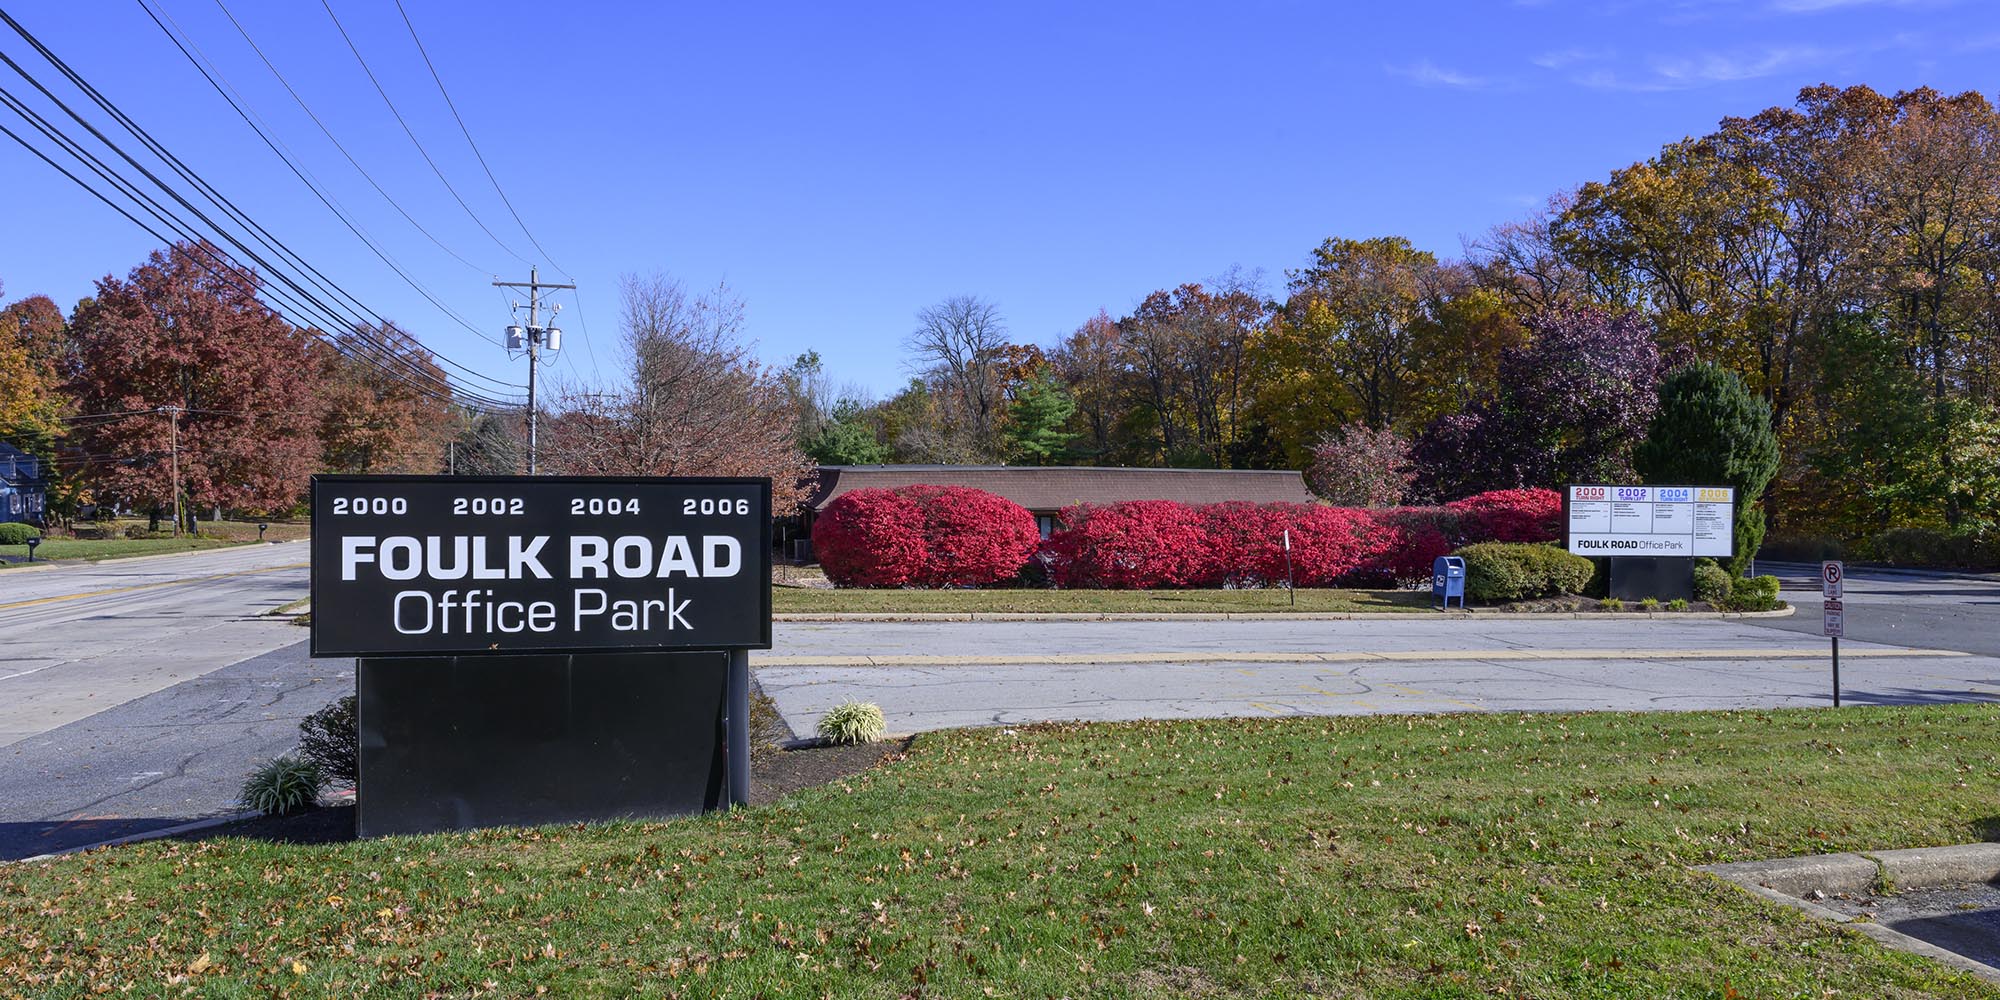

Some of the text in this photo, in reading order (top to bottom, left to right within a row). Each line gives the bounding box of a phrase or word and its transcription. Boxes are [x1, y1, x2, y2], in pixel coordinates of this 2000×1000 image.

[1576, 488, 1605, 496] 2000
[1618, 488, 1647, 497] 2002
[1659, 489, 1688, 498] 2004
[333, 497, 749, 515] 2000 2002 2004 2006
[1578, 540, 1683, 550] FOULK ROAD Office Park
[341, 535, 742, 581] FOULK ROAD
[393, 588, 694, 635] Office Park
